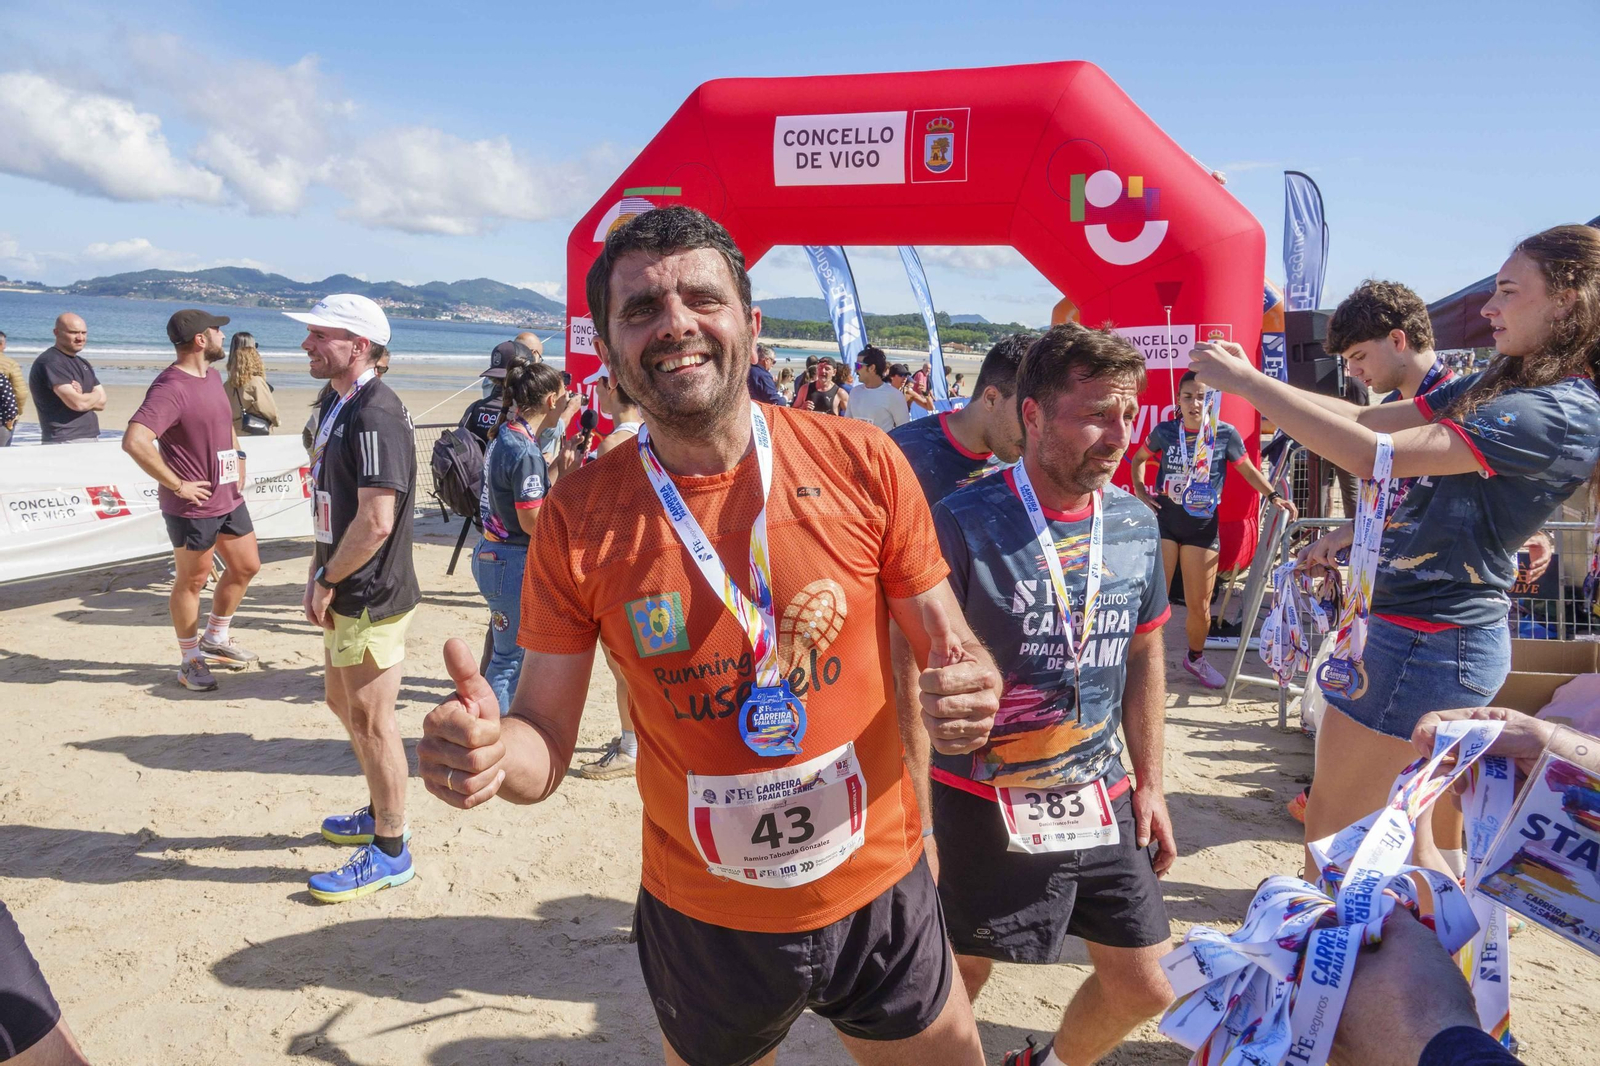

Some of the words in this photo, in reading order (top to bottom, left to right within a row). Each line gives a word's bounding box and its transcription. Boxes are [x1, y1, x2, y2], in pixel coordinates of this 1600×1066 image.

[783, 126, 894, 147] CONCELLO
[796, 152, 822, 169] DE
[829, 150, 880, 168] VIGO
[573, 325, 598, 336] CONCE
[576, 337, 585, 346] DE
[1145, 348, 1179, 360] VIGO
[225, 460, 236, 471] 451
[143, 489, 159, 498] CO
[255, 485, 267, 494] DE
[9, 495, 80, 511] CONCELLO
[660, 485, 683, 522] CARREIRA
[693, 538, 705, 554] FE
[1078, 591, 1129, 609] sguros
[1019, 642, 1064, 656] PRAIA
[653, 652, 754, 685] Running
[1046, 657, 1063, 670] DE
[753, 711, 792, 721] CARREIRA
[737, 787, 754, 801] FE
[756, 778, 802, 795] CARREIRA
[757, 790, 781, 802] PRAIA
[782, 788, 792, 798] DE
[1024, 790, 1085, 821] 383
[751, 806, 815, 849] 43
[1379, 832, 1402, 851] FE
[744, 854, 769, 863] Ramiro
[769, 848, 799, 860] Taboada
[799, 839, 831, 853] Gonzalez
[767, 870, 778, 878] FE
[780, 865, 797, 875] 100
[1350, 868, 1366, 887] PRAIA
[1345, 886, 1355, 896] DE
[1526, 893, 1567, 919] CARREIRA
[1480, 942, 1498, 963] FE
[1328, 952, 1347, 989] PRAIA
[1339, 939, 1349, 951] DE
[1308, 994, 1329, 1038] seguros
[1288, 1035, 1316, 1064] FE
